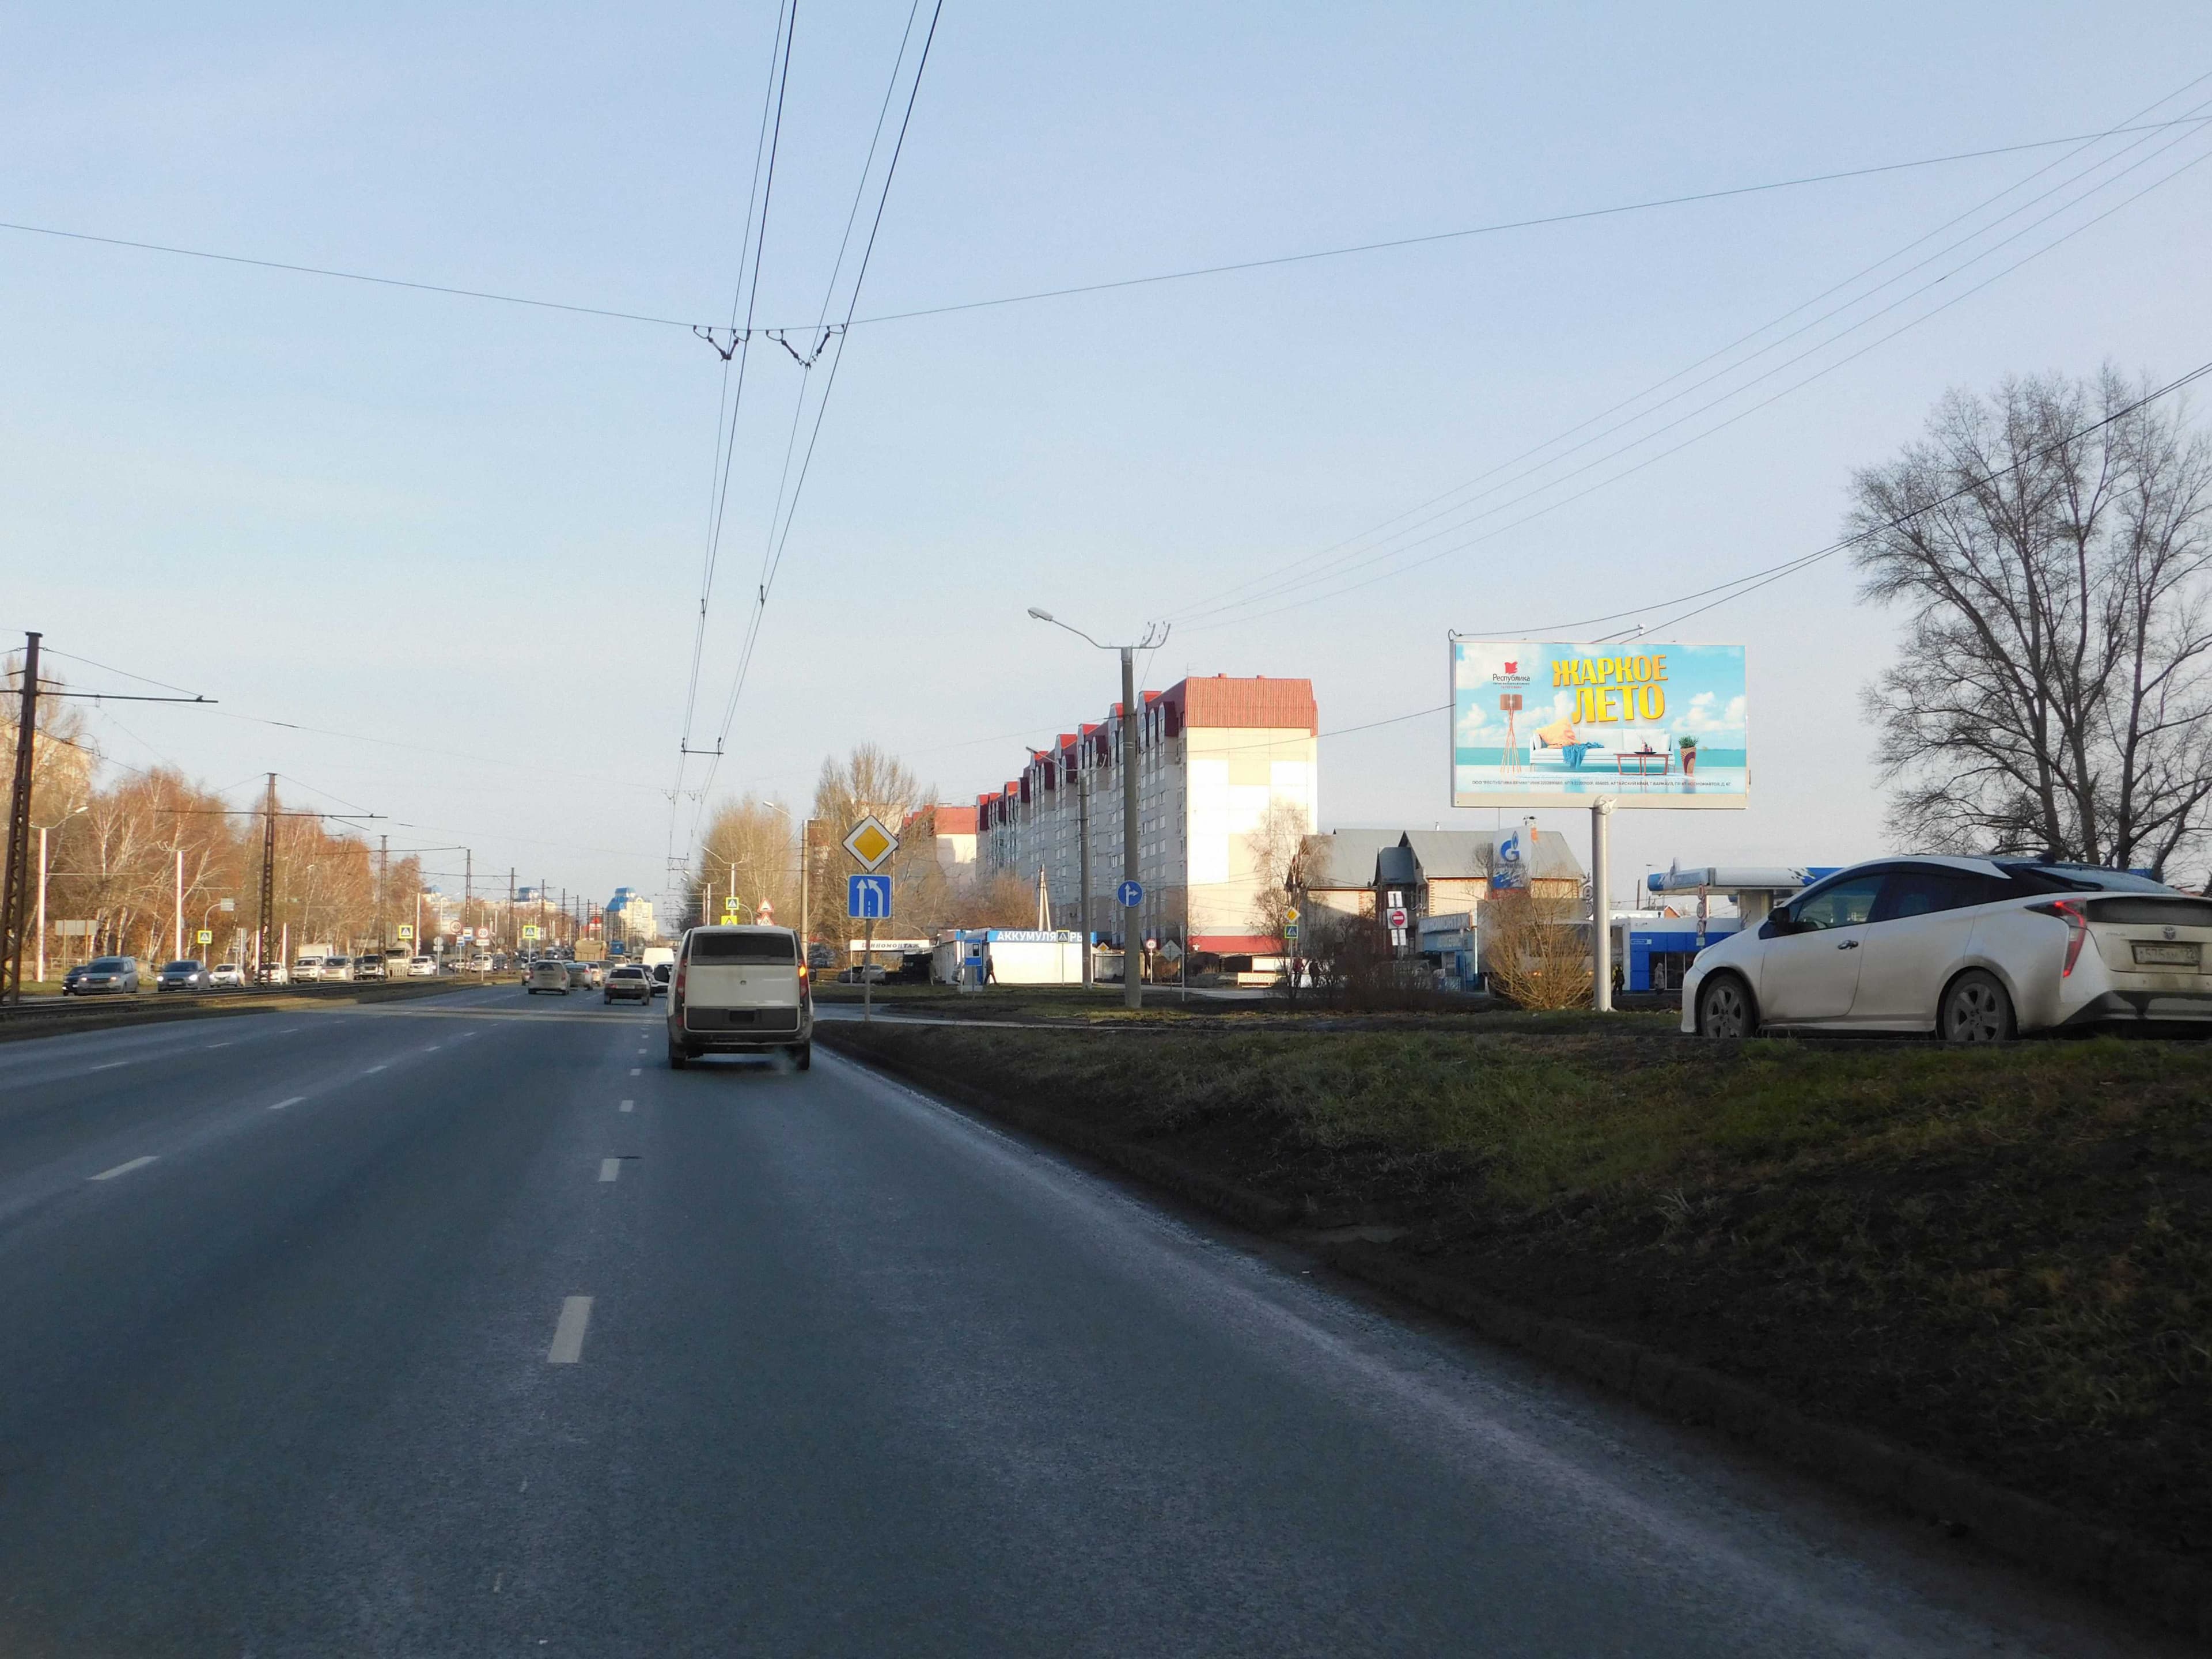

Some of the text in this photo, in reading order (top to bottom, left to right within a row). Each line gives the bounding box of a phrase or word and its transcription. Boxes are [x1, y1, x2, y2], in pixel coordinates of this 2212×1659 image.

[1493, 673, 1531, 682] Республика
[1552, 654, 1669, 687] ЖАРКОЕ
[1571, 683, 1665, 724] ЛЕТО
[997, 931, 1082, 942] АККУМУЛЯРЫ
